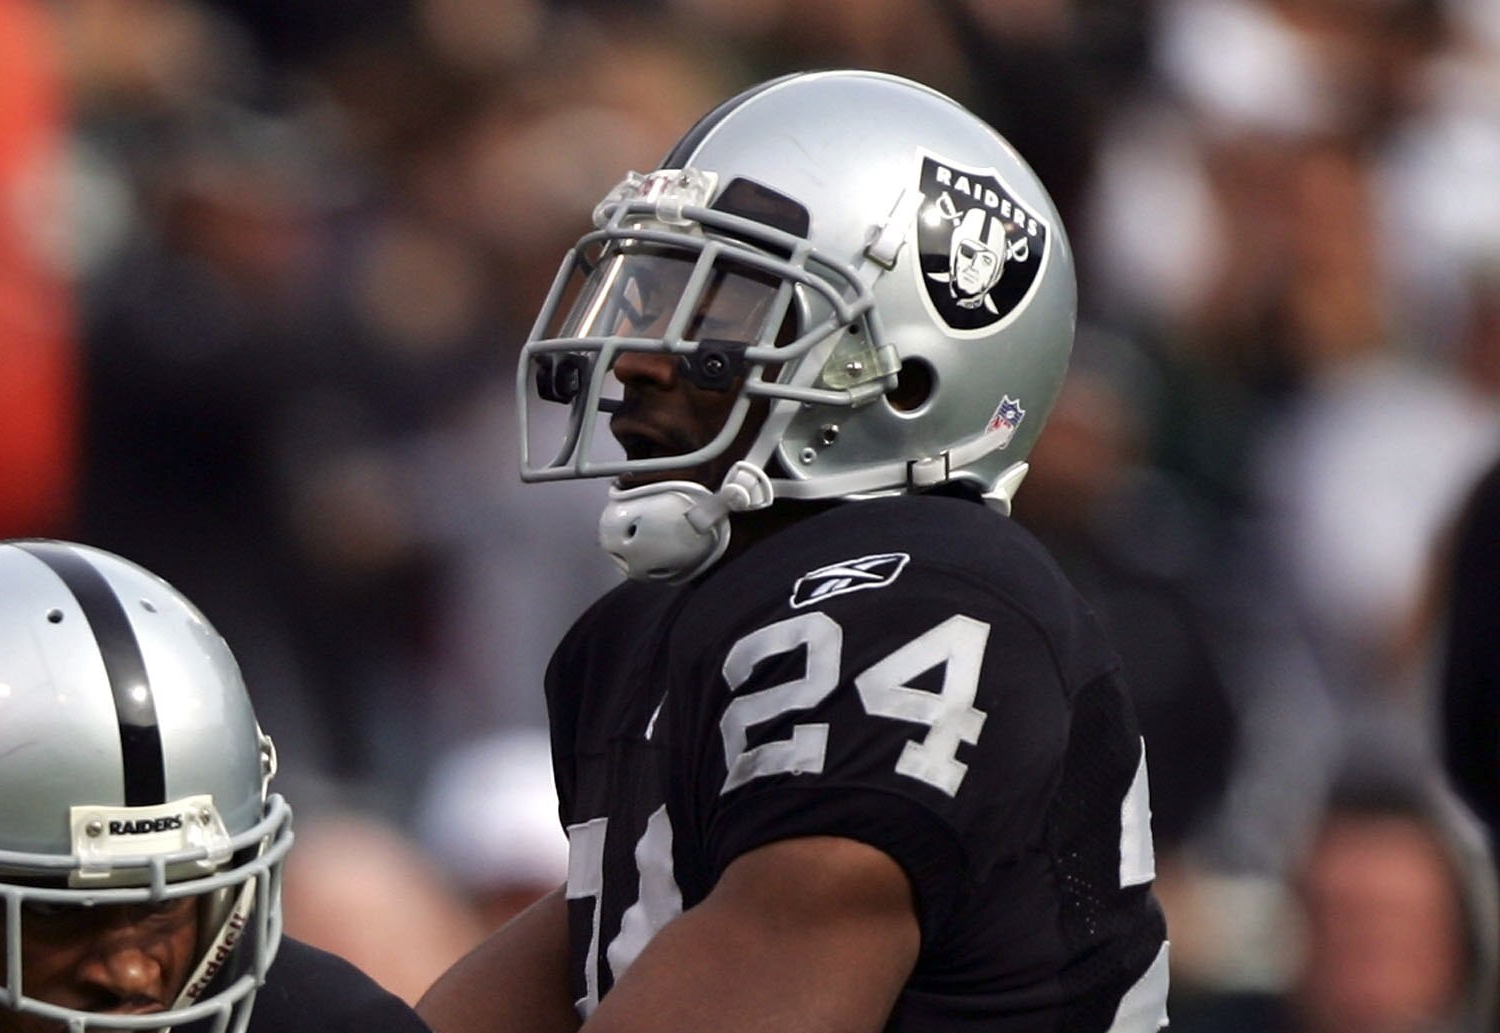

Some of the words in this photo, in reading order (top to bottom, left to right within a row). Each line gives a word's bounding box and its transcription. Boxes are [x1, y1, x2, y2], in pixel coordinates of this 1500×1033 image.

[935, 165, 1038, 237] RAIDERS
[719, 611, 992, 799] 24
[108, 814, 183, 836] RAIDERS
[186, 912, 246, 999] Riddell
